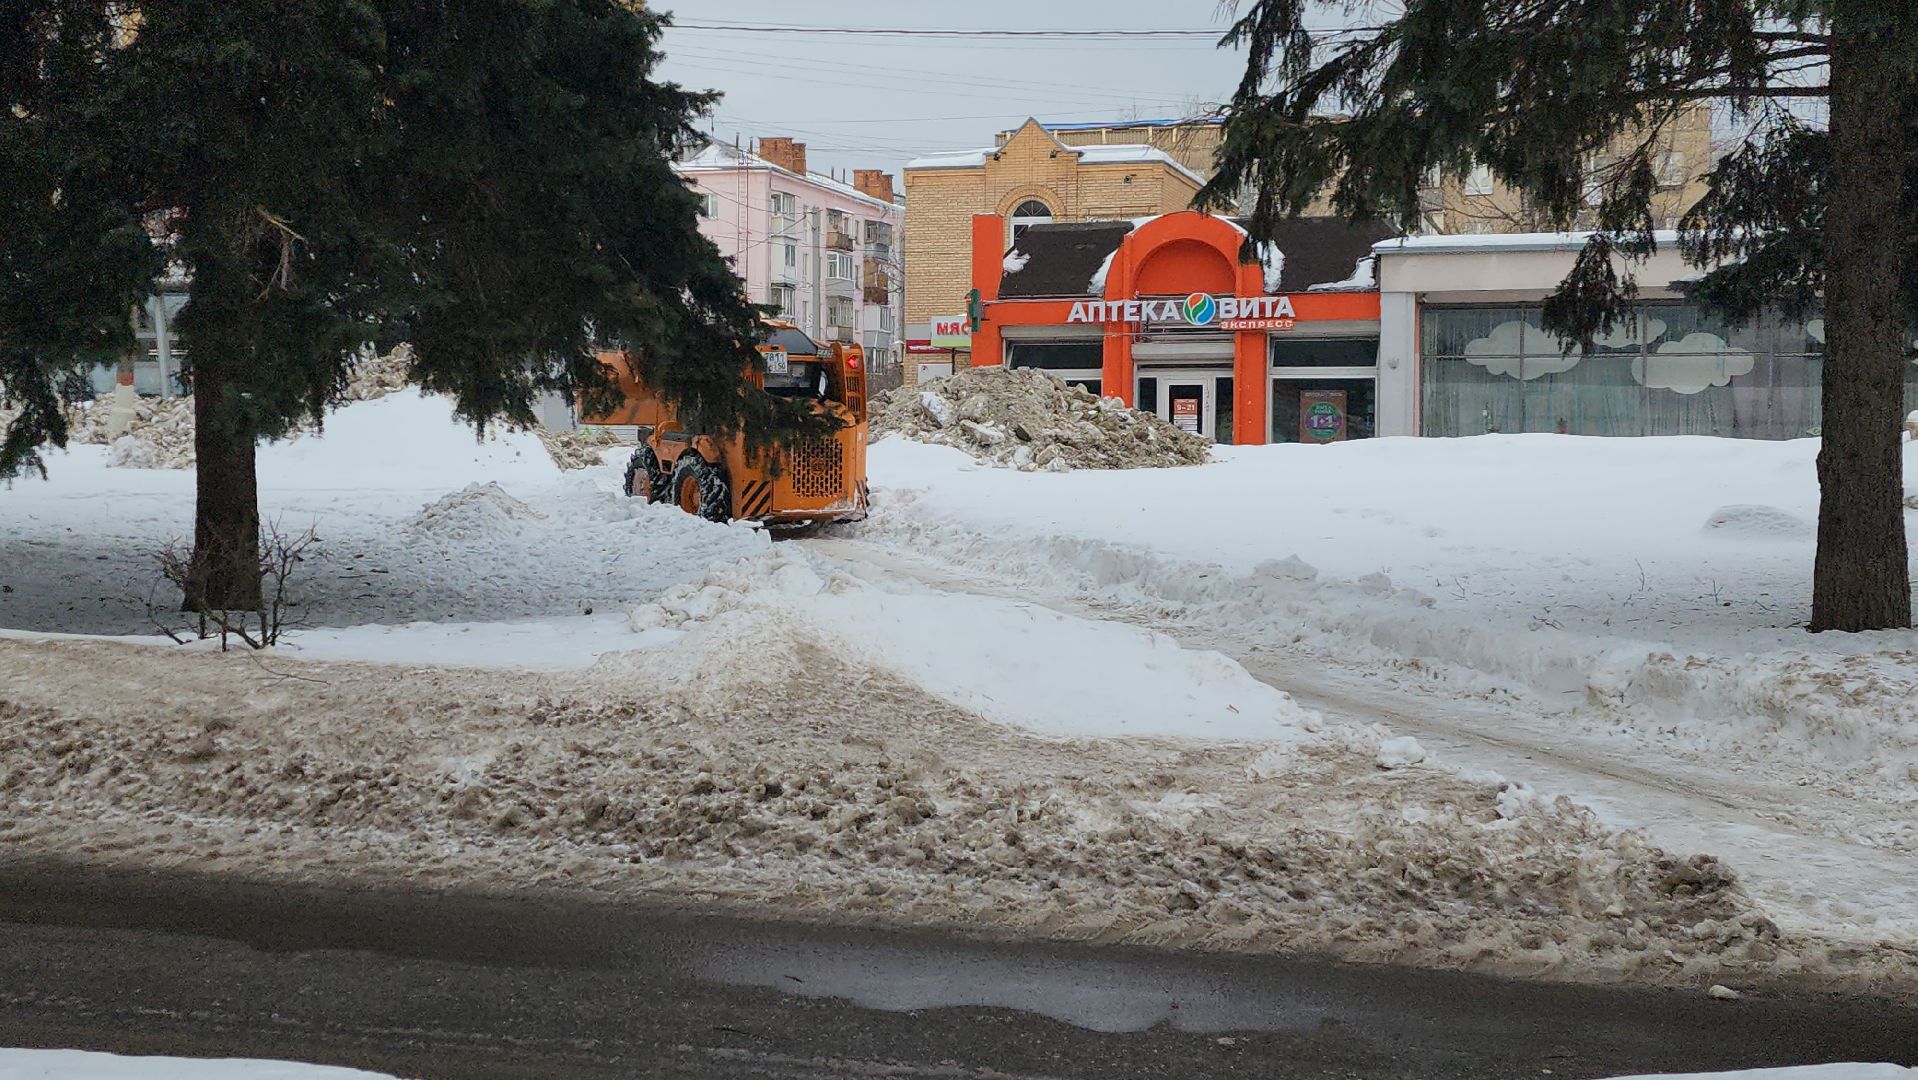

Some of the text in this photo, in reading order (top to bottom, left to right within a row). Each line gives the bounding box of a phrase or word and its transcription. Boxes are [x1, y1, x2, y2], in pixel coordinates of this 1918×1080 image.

[1066, 296, 1296, 323] АПТЕКА ВИТА
[1220, 319, 1295, 329] ЭКСПРЕСС
